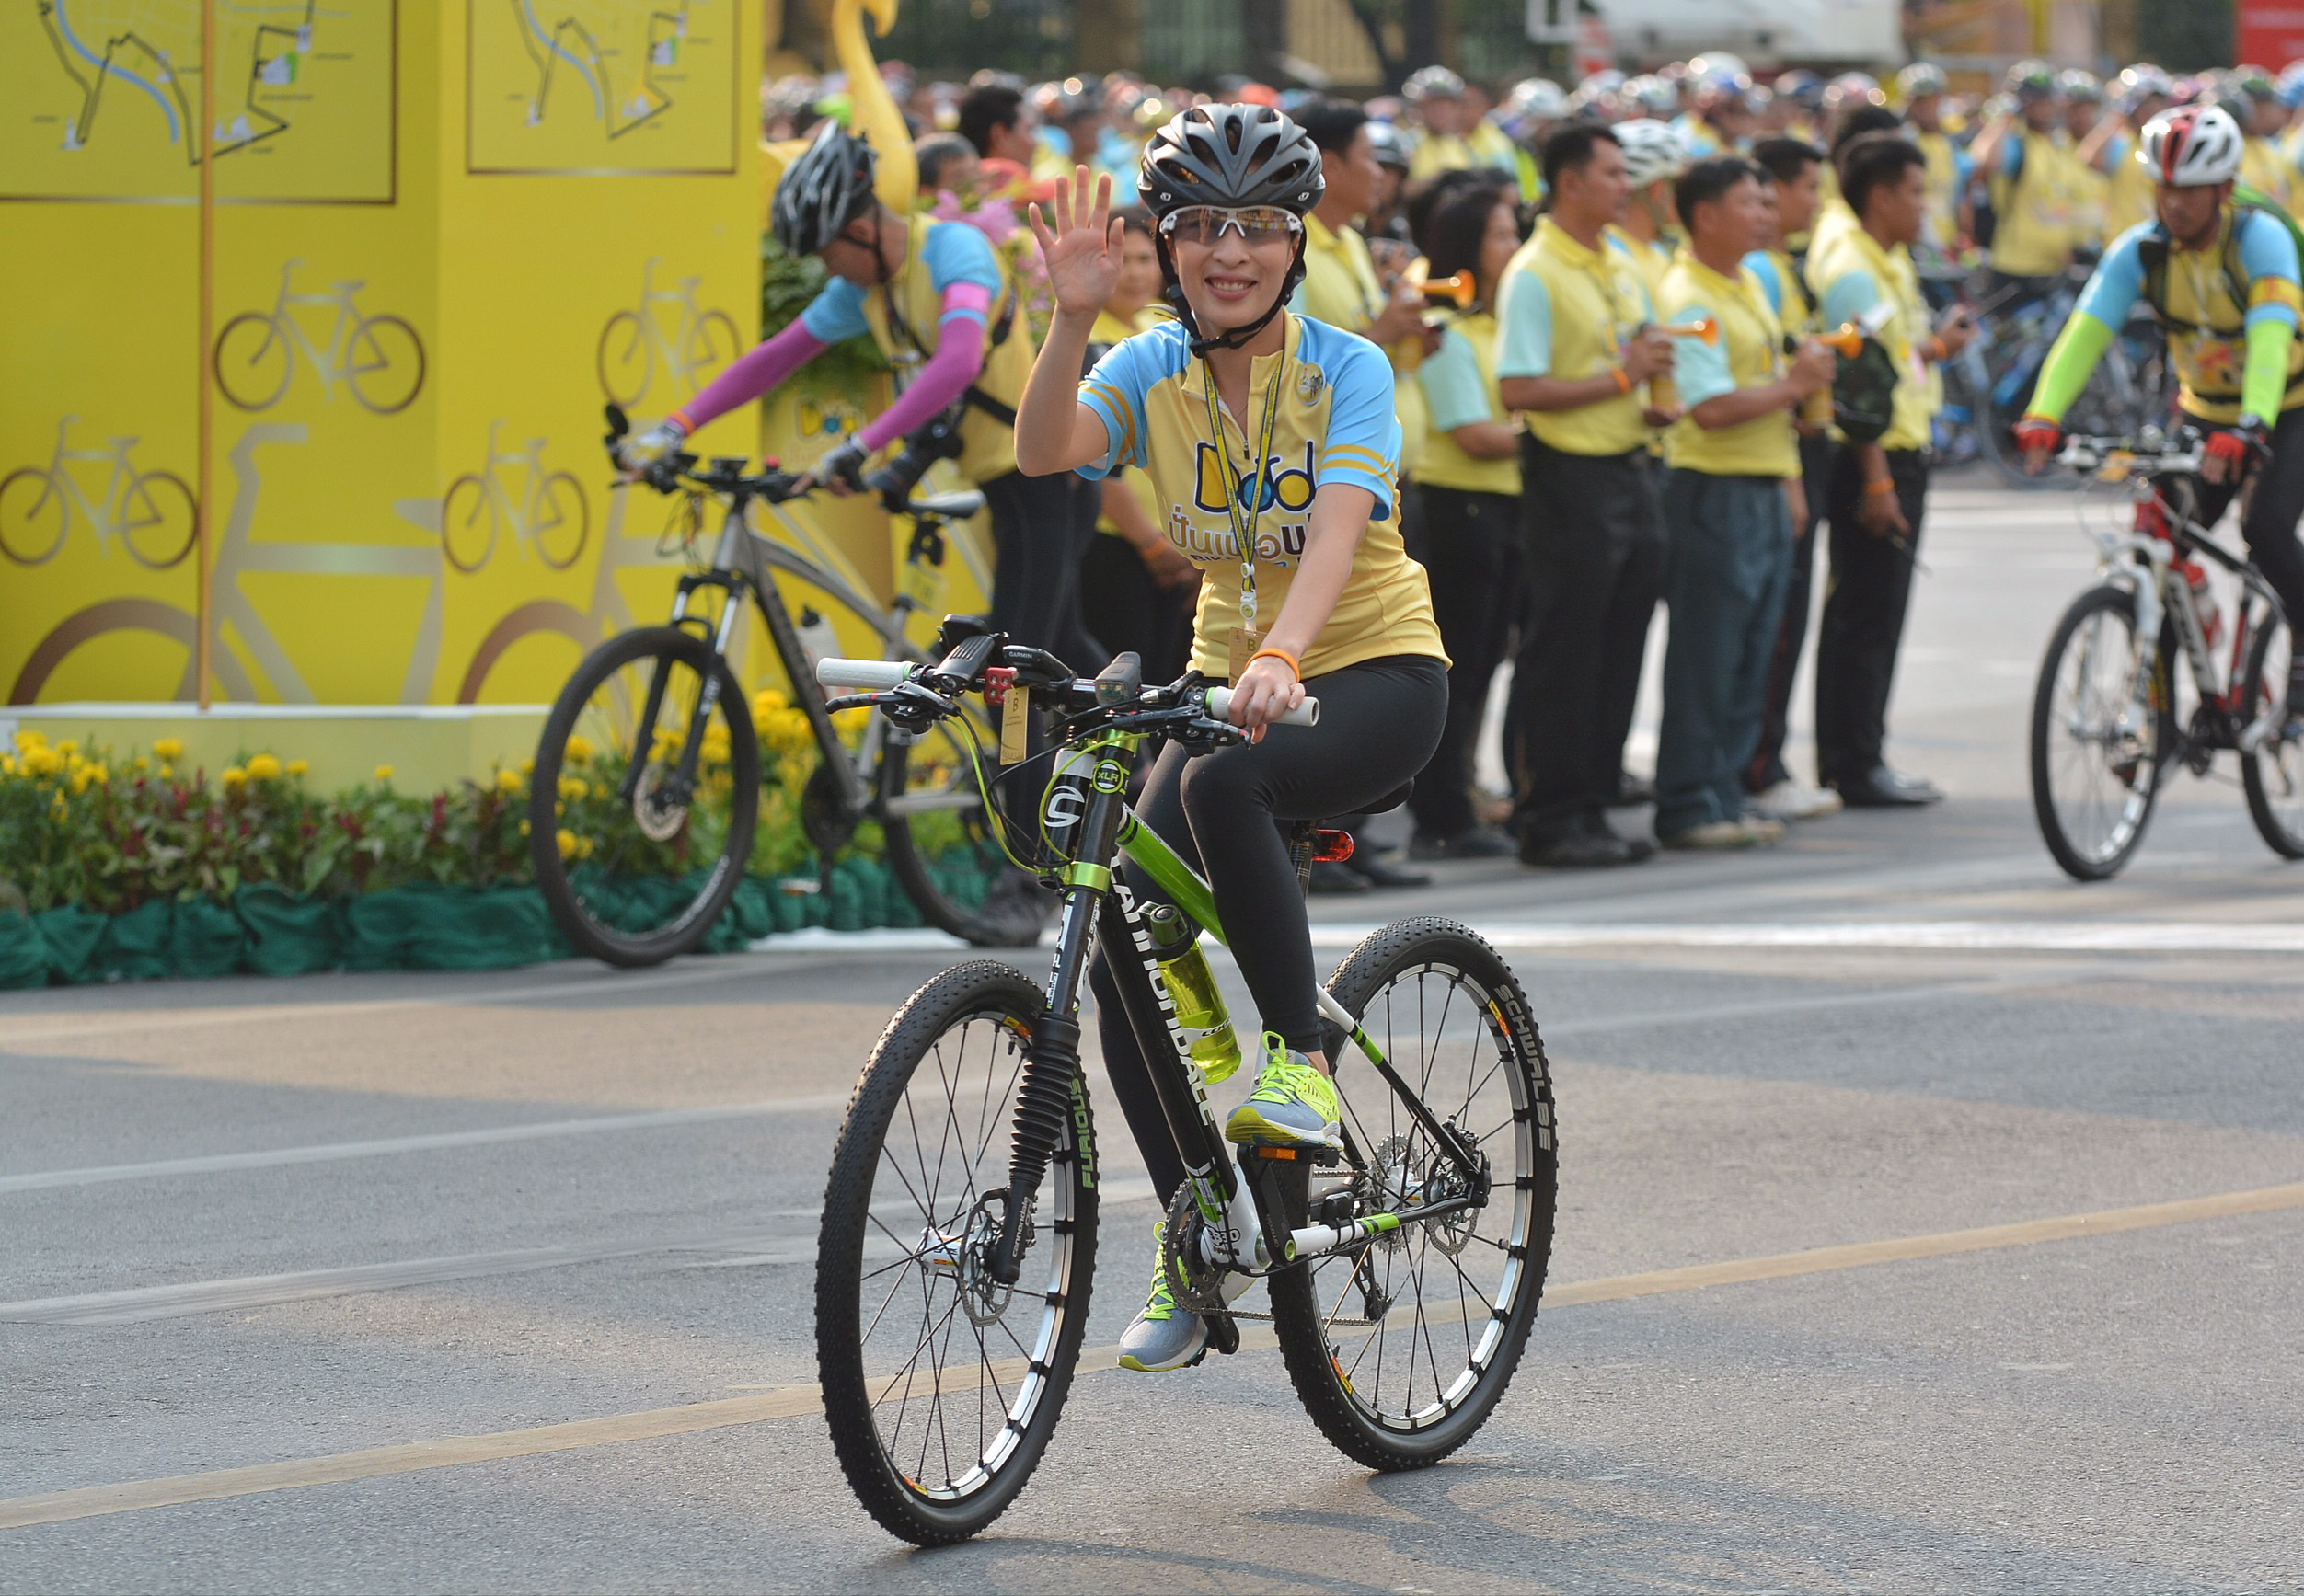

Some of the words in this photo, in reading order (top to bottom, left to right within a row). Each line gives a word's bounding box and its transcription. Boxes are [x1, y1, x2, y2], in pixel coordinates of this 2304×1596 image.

[1009, 651, 1032, 660] GARMIN
[1097, 772, 1119, 782] XLR
[1493, 983, 1551, 1152] SCHWALBE
[1069, 1077, 1095, 1189] FURIOUS
